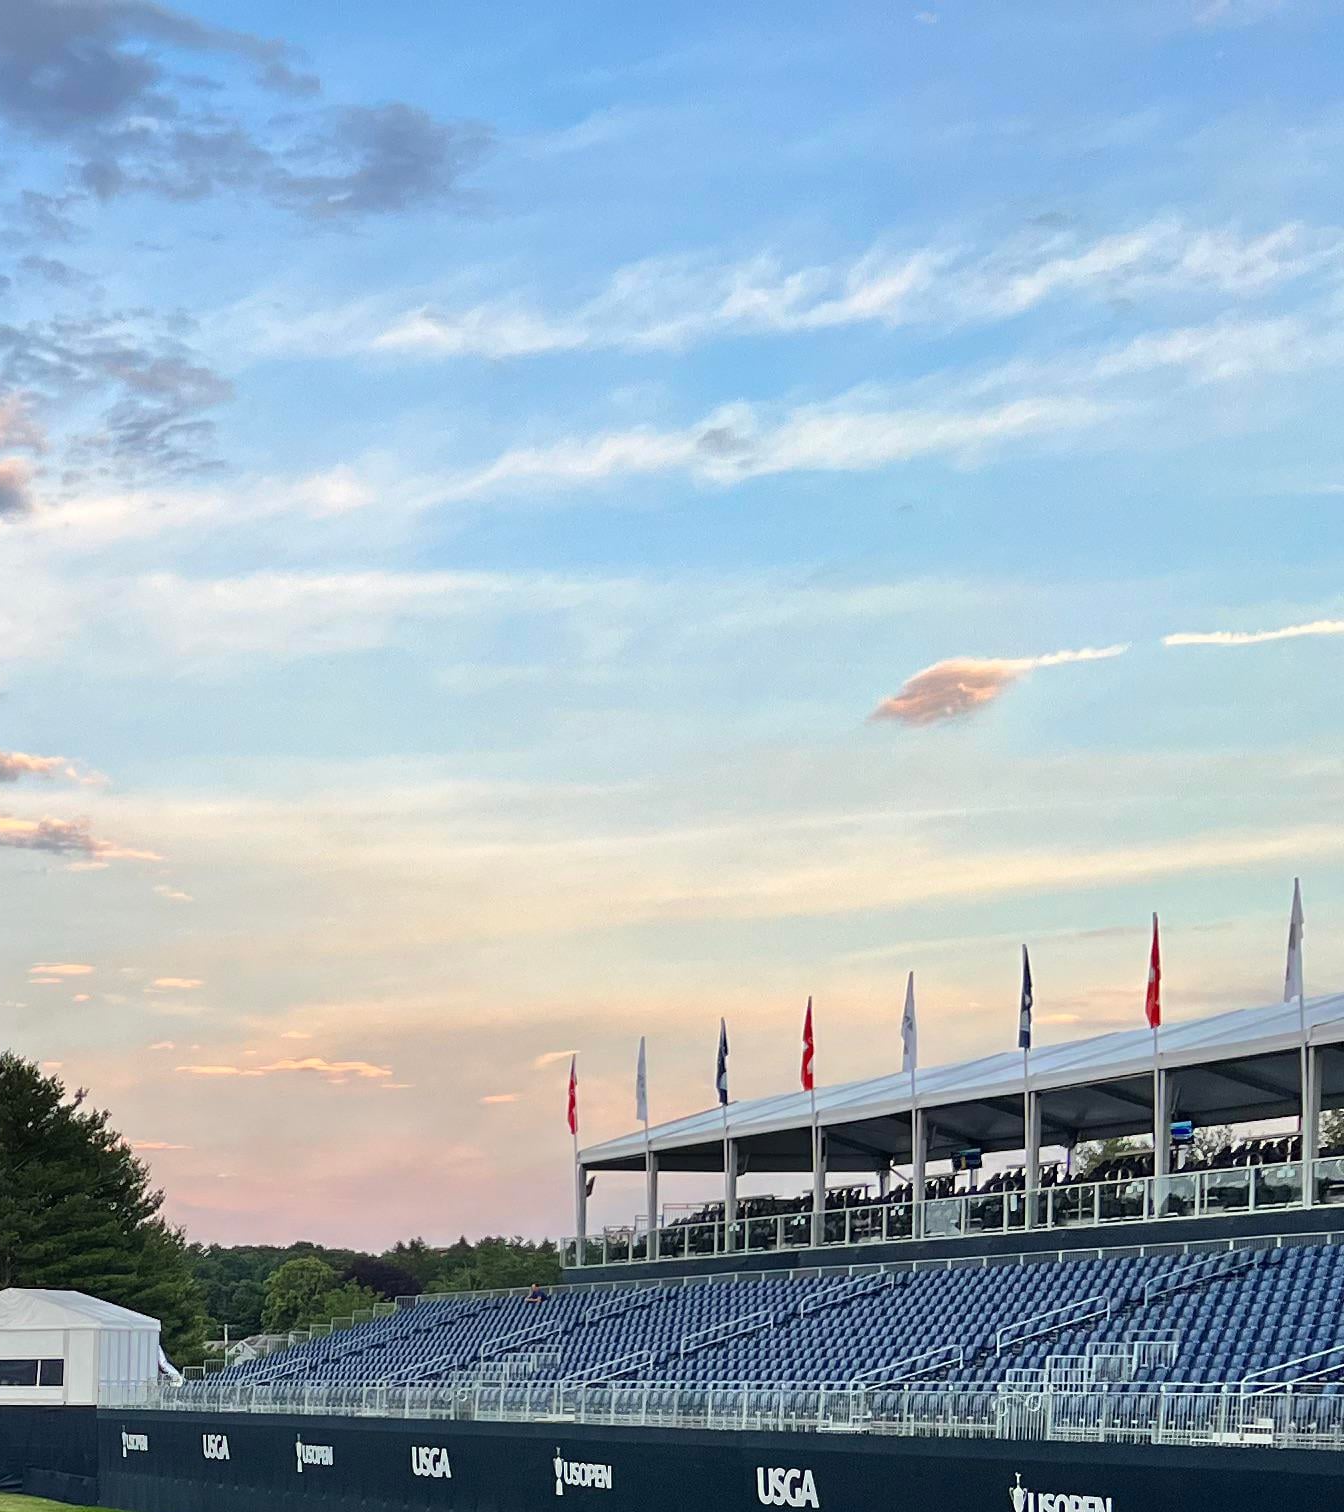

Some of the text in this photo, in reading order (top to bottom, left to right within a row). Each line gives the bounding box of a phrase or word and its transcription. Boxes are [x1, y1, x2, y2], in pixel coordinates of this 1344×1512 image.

[202, 1434, 230, 1460] USGA
[412, 1446, 452, 1479] USGA
[756, 1466, 820, 1509] USGA
